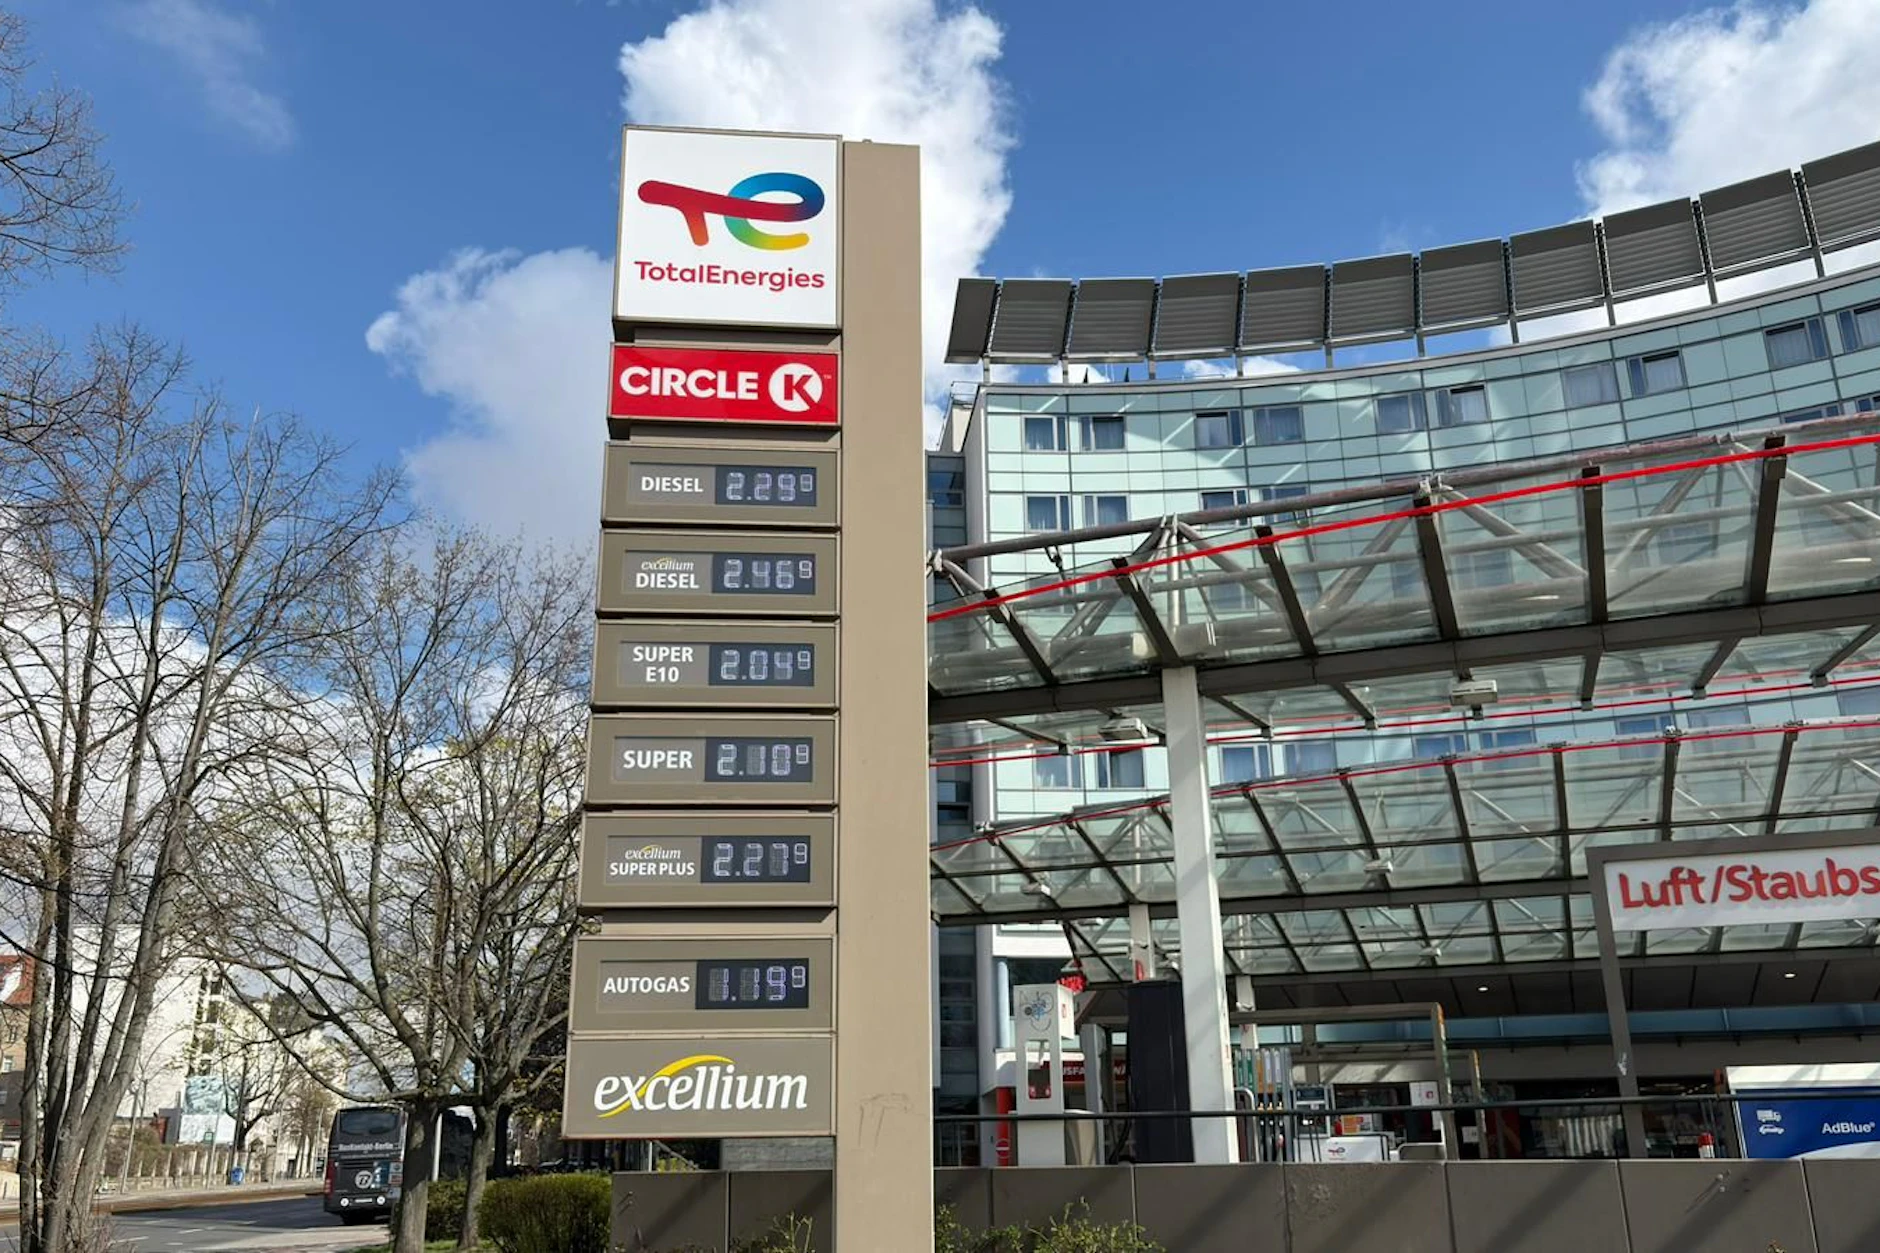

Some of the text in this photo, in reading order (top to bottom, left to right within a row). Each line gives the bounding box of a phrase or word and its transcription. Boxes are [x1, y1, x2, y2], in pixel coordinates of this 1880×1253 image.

[634, 261, 825, 291] TotalEnergies
[620, 366, 822, 409] CIRCLE K
[641, 476, 703, 493] DIESEL
[641, 557, 694, 571] excellium
[636, 573, 699, 589] DIESEL
[633, 646, 694, 663] SUPER
[646, 666, 679, 683] E10
[623, 750, 693, 769] SUPER
[625, 844, 681, 859] excellium
[610, 862, 657, 876] SUPER
[659, 862, 695, 876] PLUS
[603, 976, 691, 994] AUTOGAS
[594, 1064, 808, 1111] excellium
